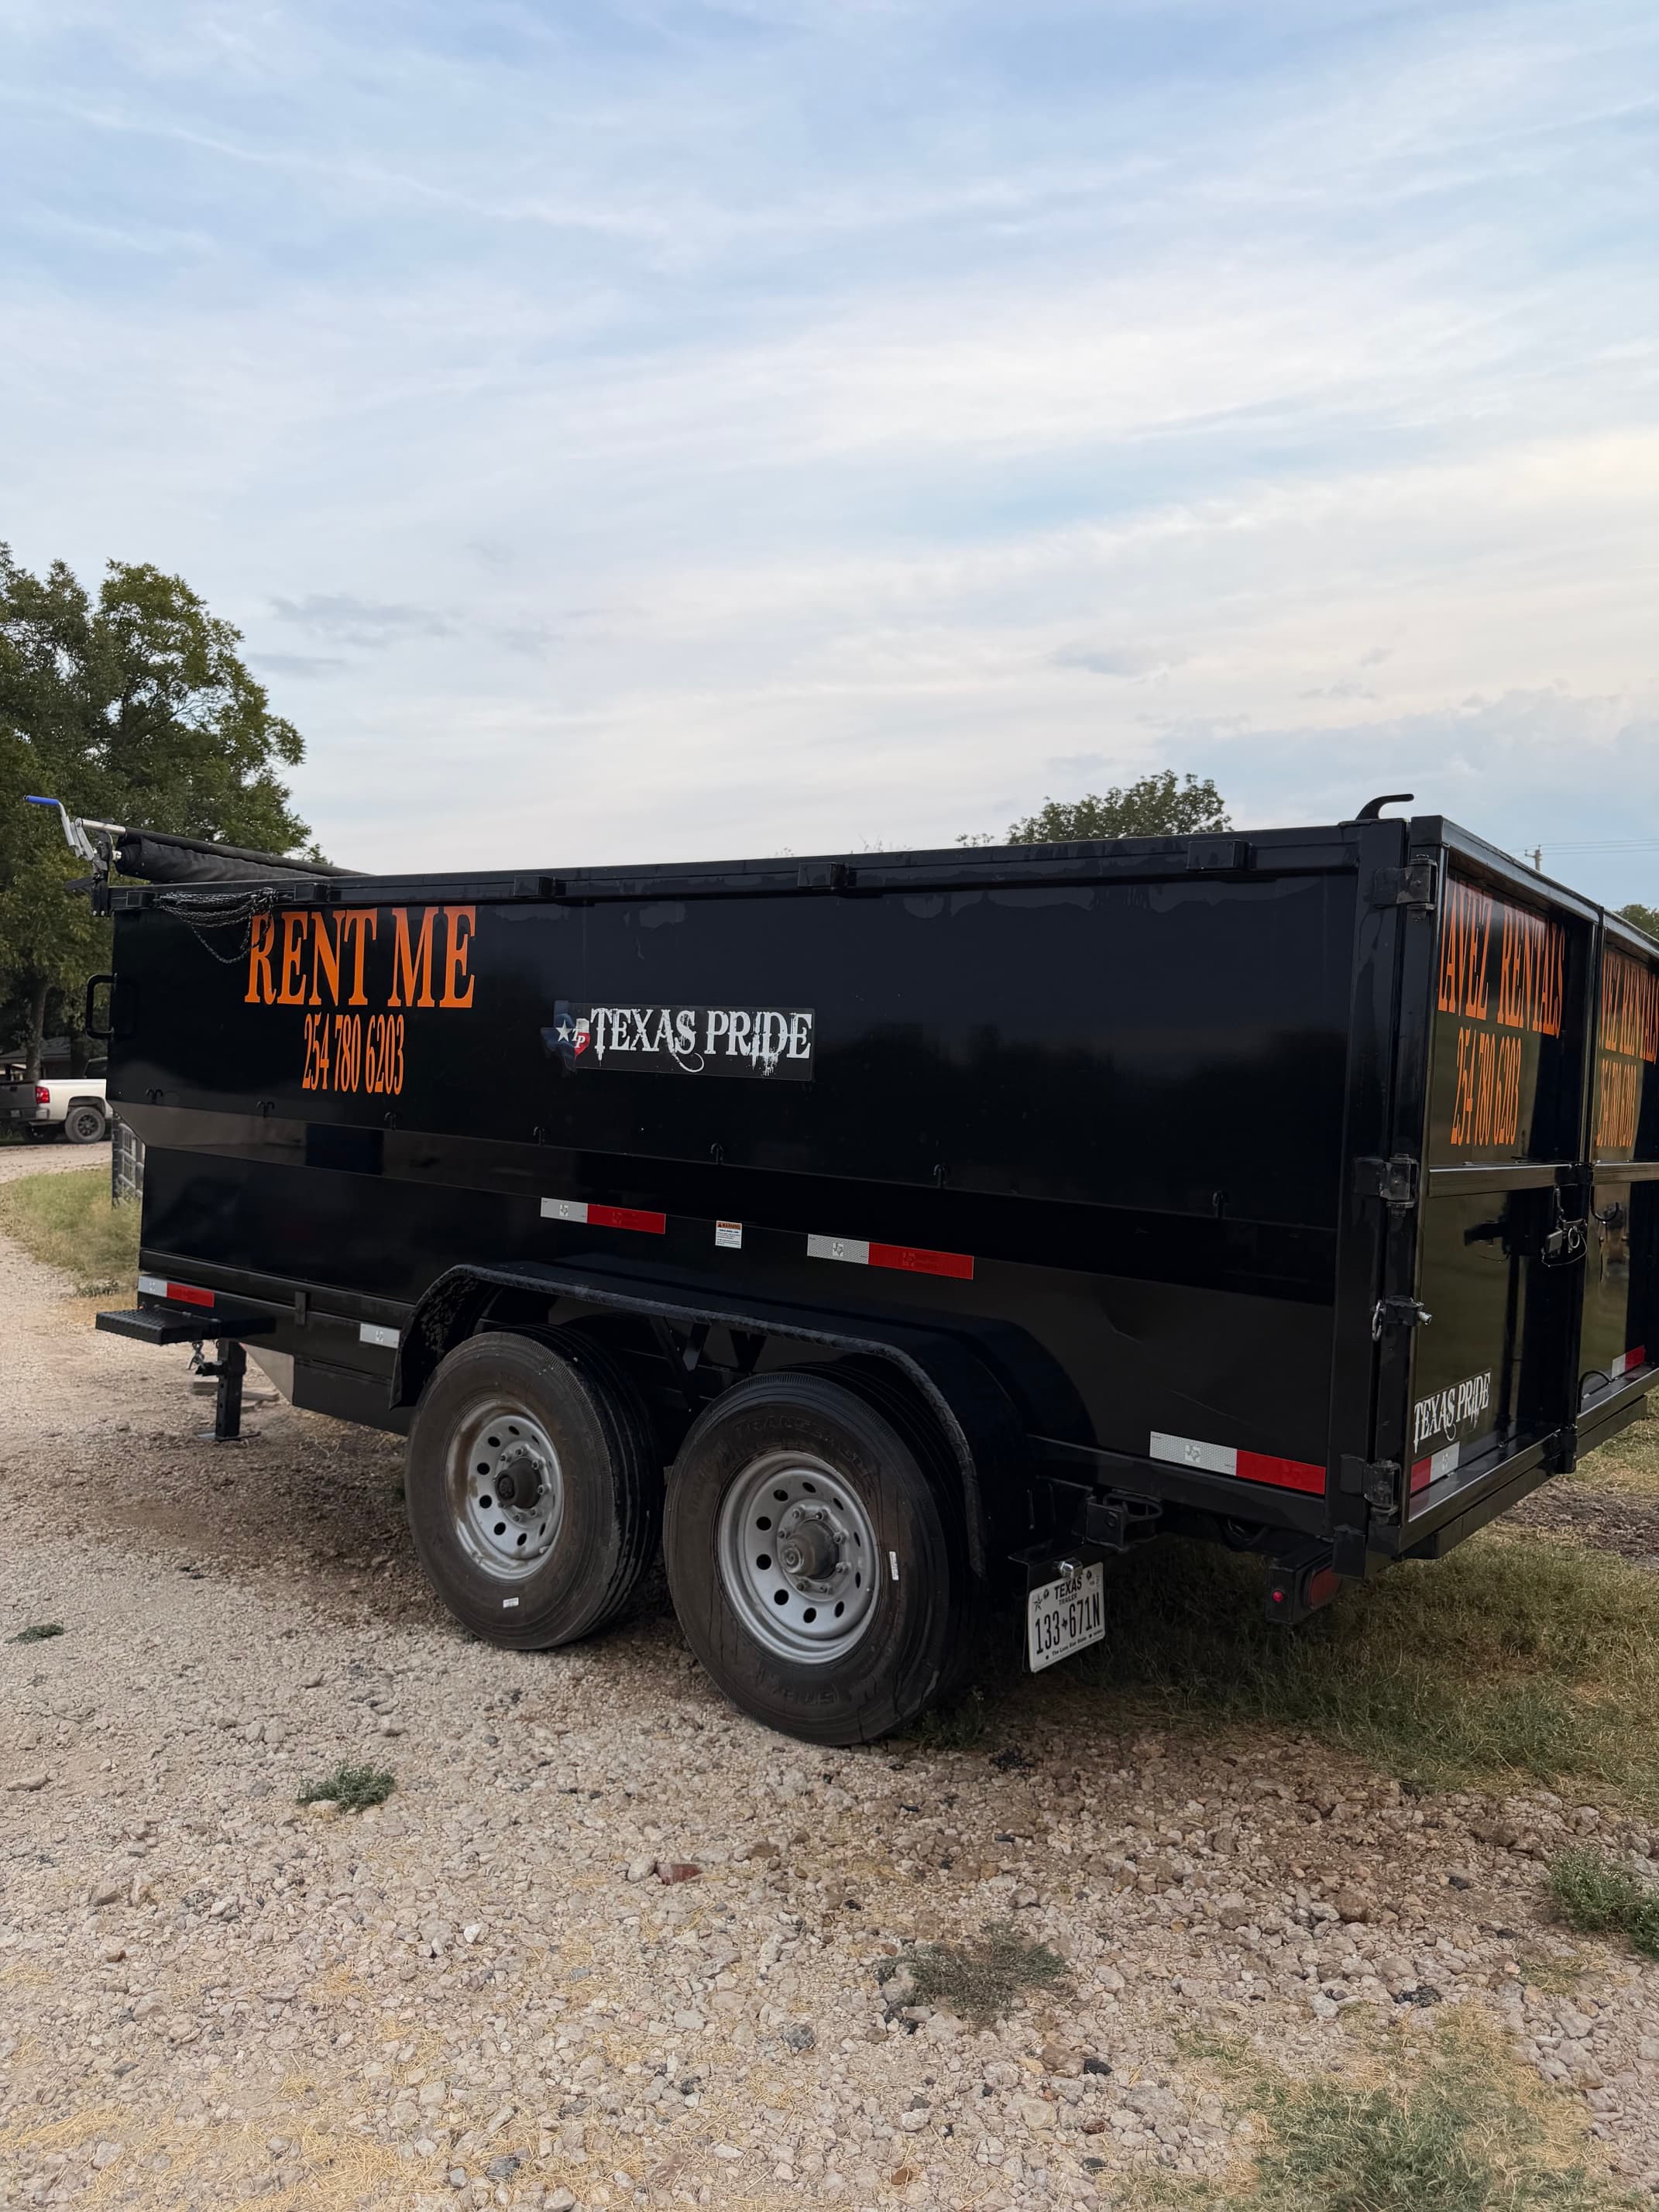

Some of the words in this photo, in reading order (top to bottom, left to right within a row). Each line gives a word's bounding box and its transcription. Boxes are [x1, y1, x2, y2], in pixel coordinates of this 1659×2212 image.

[244, 908, 378, 1006] RENT
[387, 905, 476, 1008] ME
[1497, 898, 1565, 1039] RENTALS
[302, 1012, 330, 1091] 254
[335, 1014, 361, 1093] 780
[365, 1014, 404, 1095] 6203
[591, 1008, 704, 1073] TEXAS
[704, 1010, 812, 1074] PRIDE
[1450, 1027, 1476, 1146] 254
[1474, 1032, 1496, 1147] 780
[1493, 1036, 1521, 1147] 6203
[1413, 1388, 1456, 1453] TEXAS
[1456, 1372, 1491, 1429] PRIDE
[1054, 1576, 1082, 1599] TEXAS
